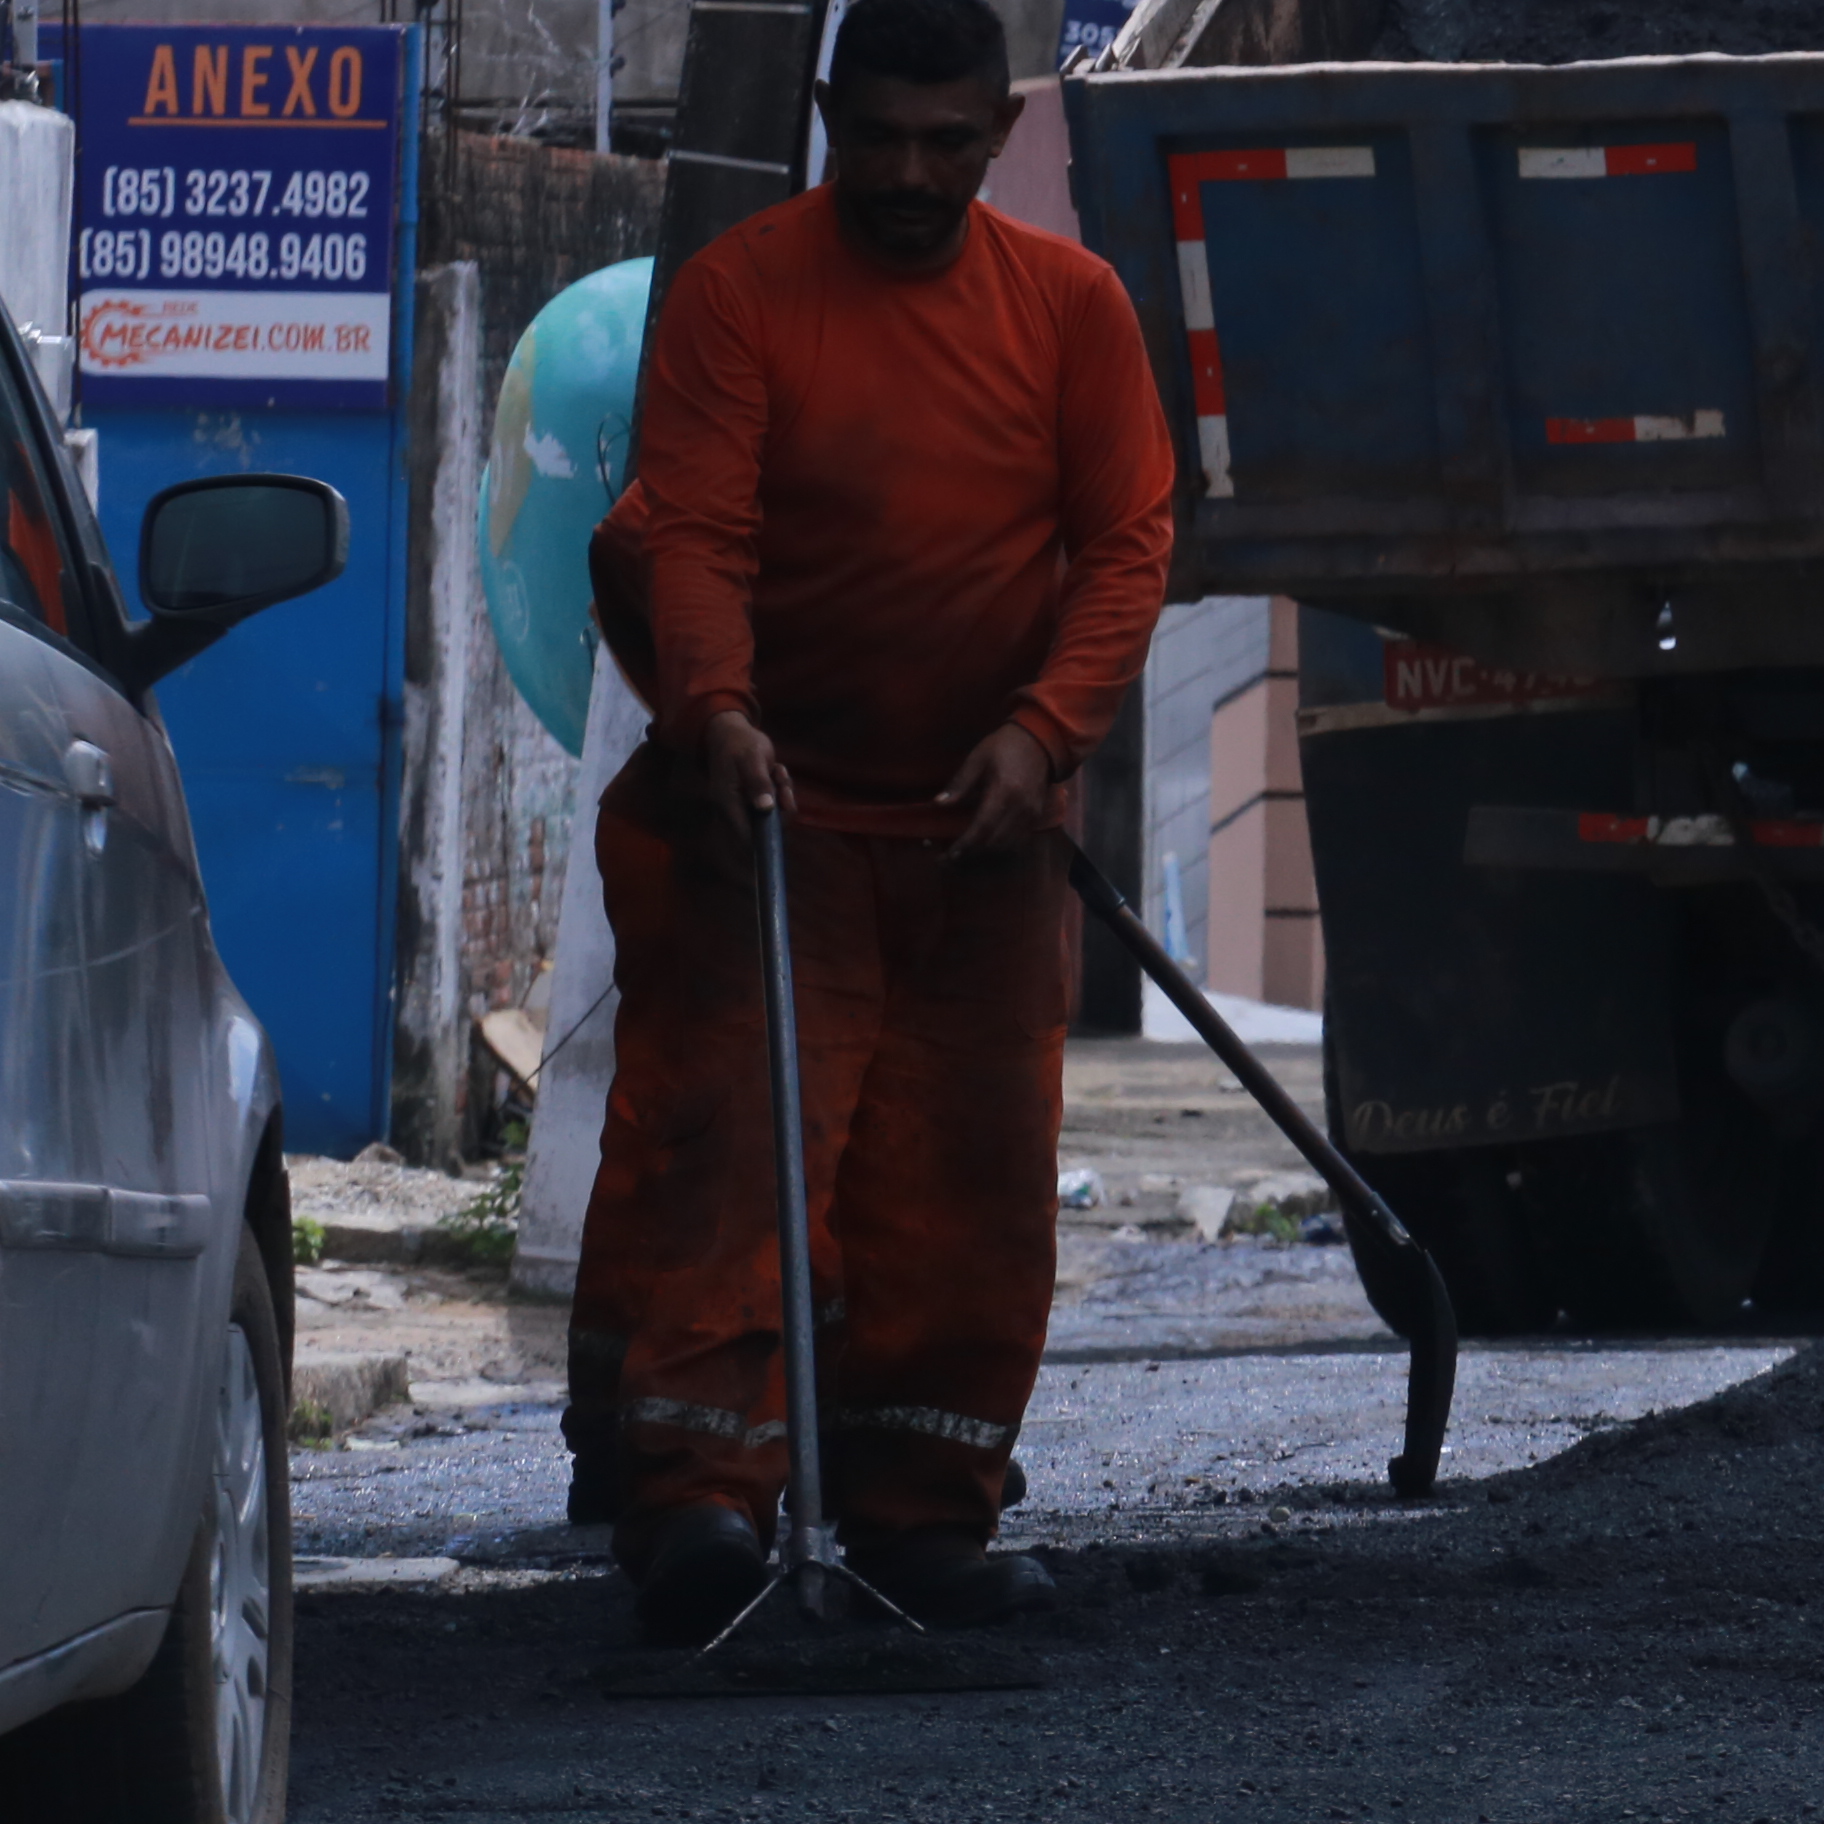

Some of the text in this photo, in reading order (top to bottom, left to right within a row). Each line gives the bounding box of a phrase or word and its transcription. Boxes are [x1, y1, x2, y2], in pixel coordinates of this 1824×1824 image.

[143, 44, 363, 118] ANEXO
[103, 166, 370, 218] (85) 3237.4982
[80, 228, 367, 281] (85) 98948.9406
[100, 323, 371, 354] MECANIZEI.COM.BR
[1352, 1099, 1471, 1140] Deus
[1527, 1074, 1622, 1130] Fiel
